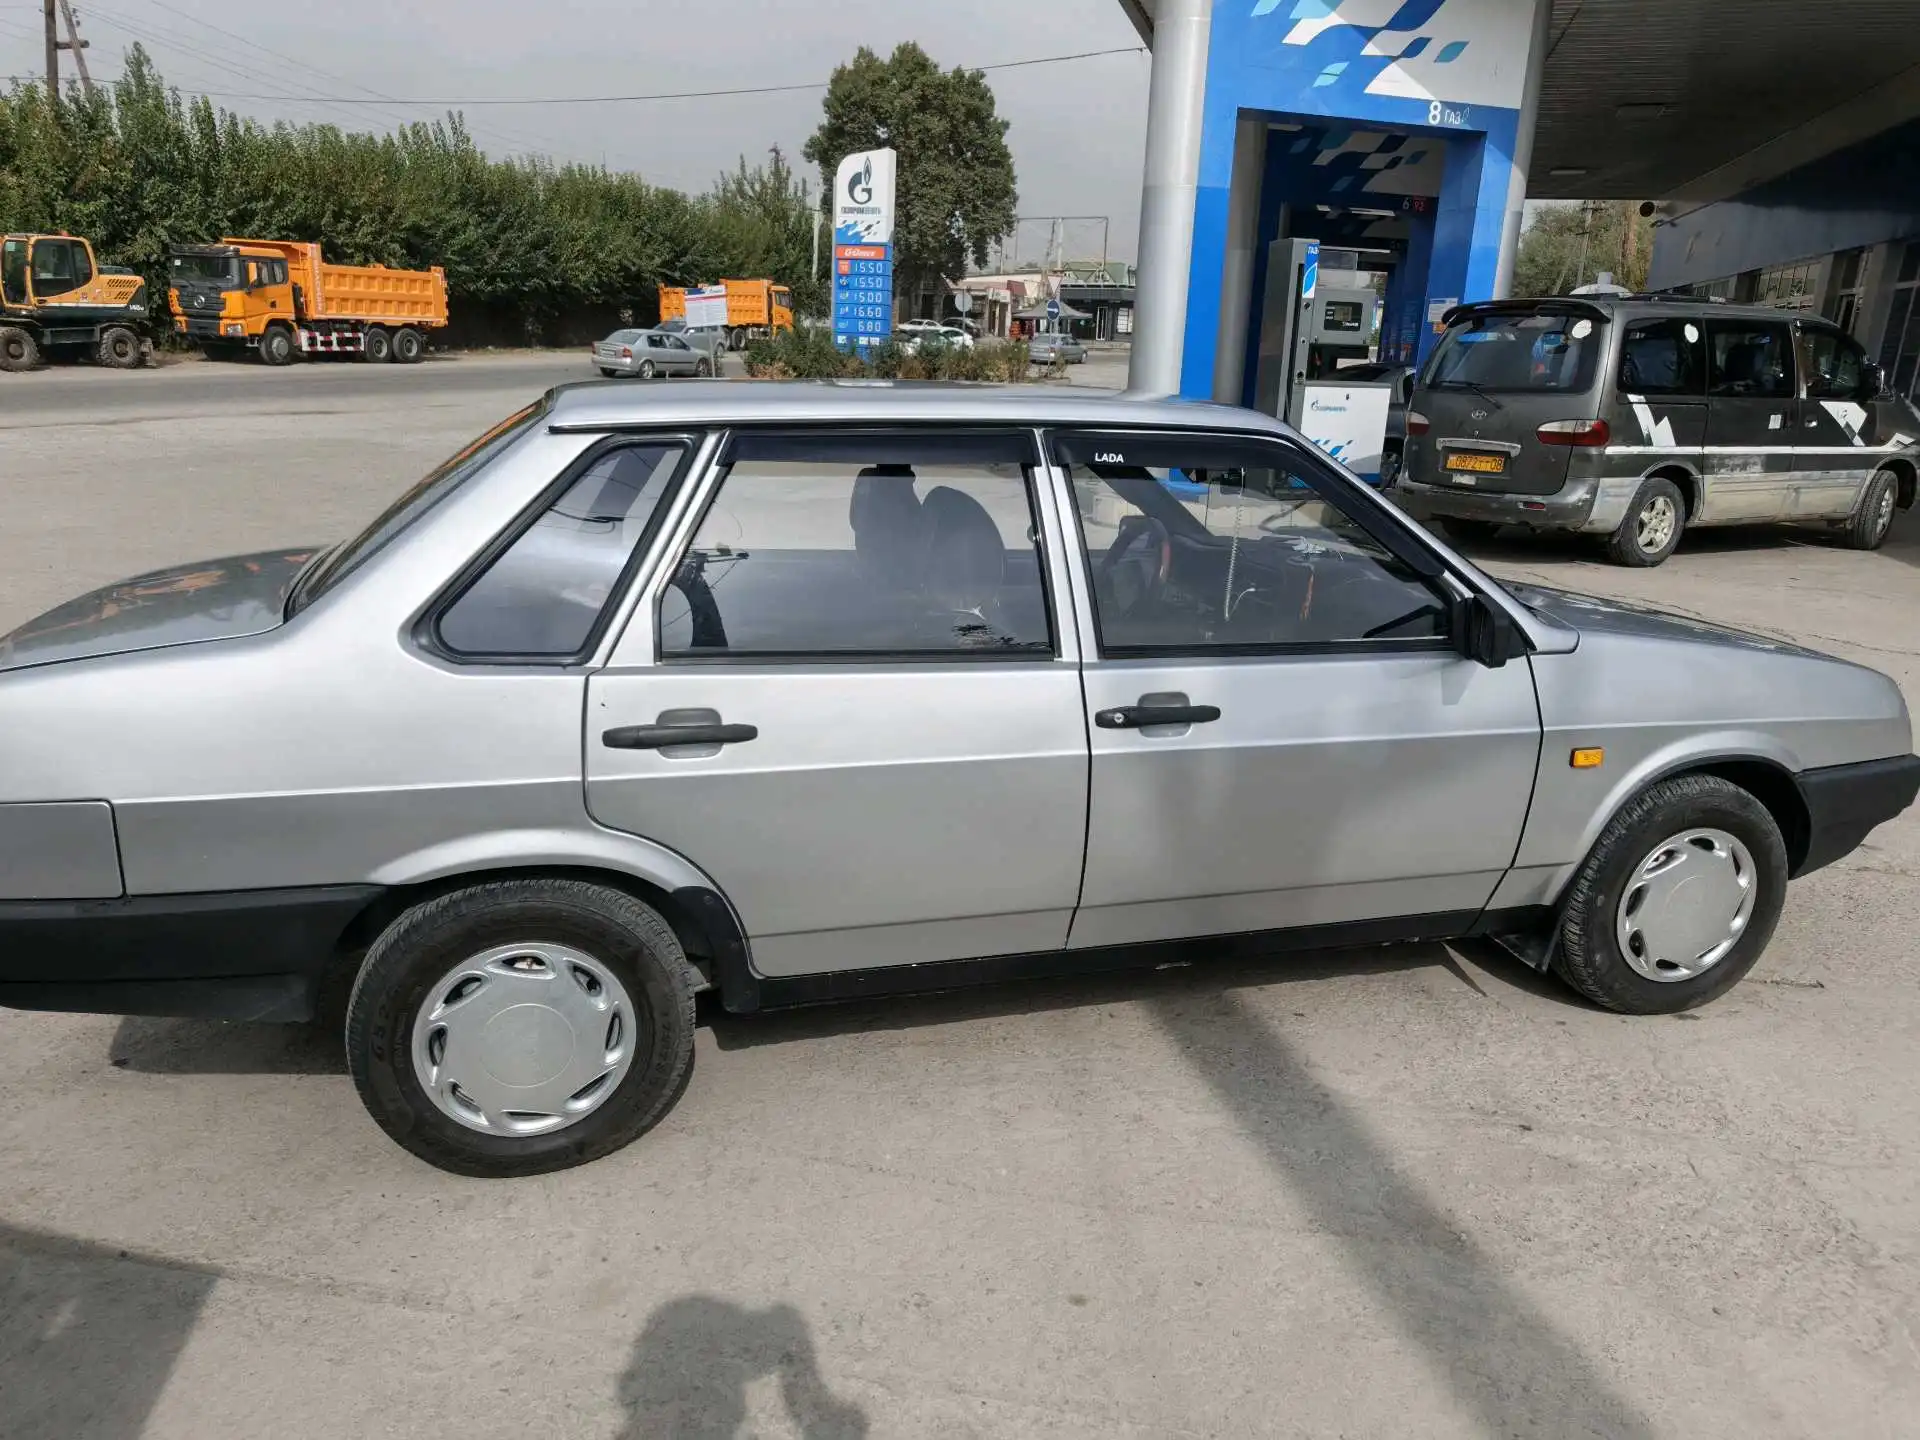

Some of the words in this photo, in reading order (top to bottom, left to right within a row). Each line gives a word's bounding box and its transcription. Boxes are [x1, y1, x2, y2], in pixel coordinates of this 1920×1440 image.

[1428, 101, 1442, 125] 8
[1444, 109, 1461, 125] ГАЗ
[1095, 452, 1124, 463] LADA
